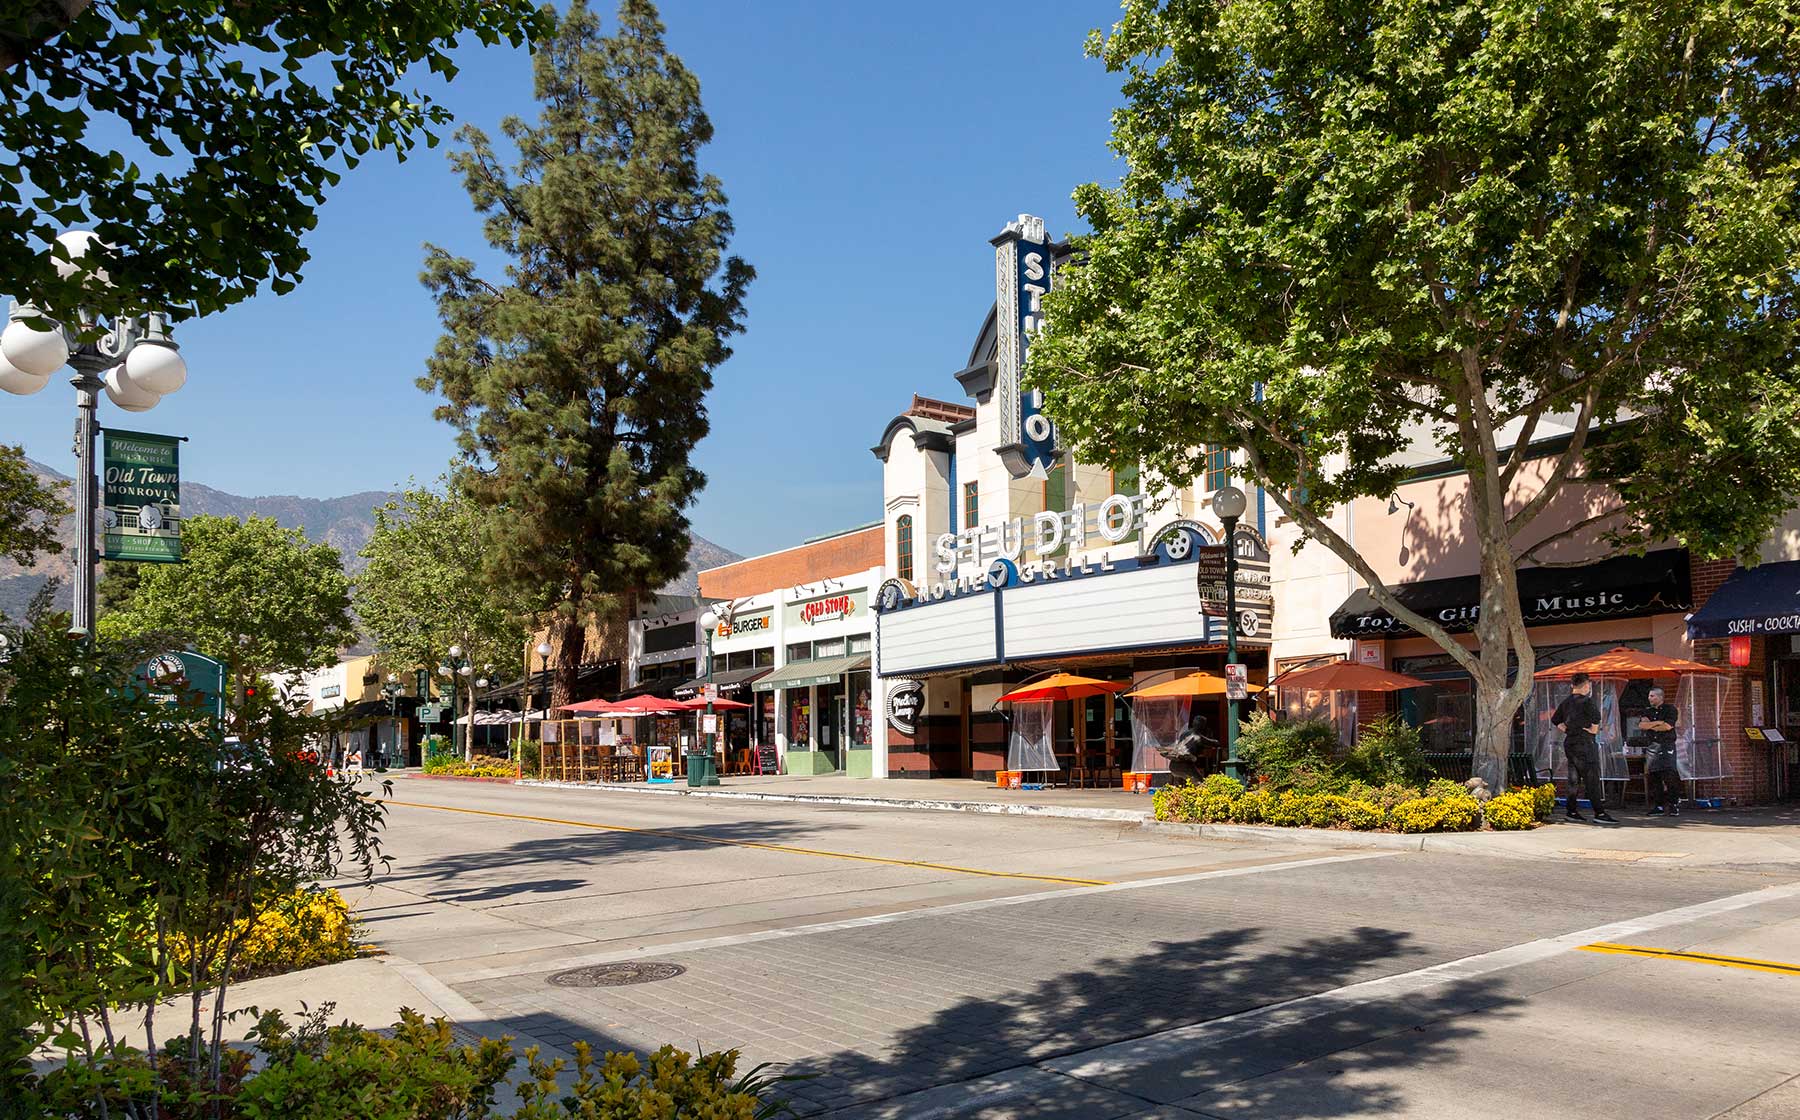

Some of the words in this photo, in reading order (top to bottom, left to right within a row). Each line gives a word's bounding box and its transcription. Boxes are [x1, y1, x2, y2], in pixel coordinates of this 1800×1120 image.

[1023, 252, 1050, 442] STUIO
[111, 439, 158, 454] Welcome
[161, 447, 170, 456] to
[120, 453, 167, 464] HISTORIC
[106, 466, 135, 484] Old
[138, 467, 178, 485] Town
[107, 484, 177, 499] MONROVIA
[935, 493, 1135, 575] STUDIO
[916, 573, 986, 603] MOVIE
[1020, 552, 1115, 583] GRILL
[805, 602, 824, 622] COLD
[825, 595, 849, 615] STONE
[1535, 591, 1624, 613] Music
[1356, 616, 1407, 629] Toy
[1438, 605, 1480, 621] Gif
[1728, 619, 1755, 634] SUSHI
[164, 655, 183, 671] TOWN
[1227, 666, 1236, 675] NO
[422, 708, 431, 719] P
